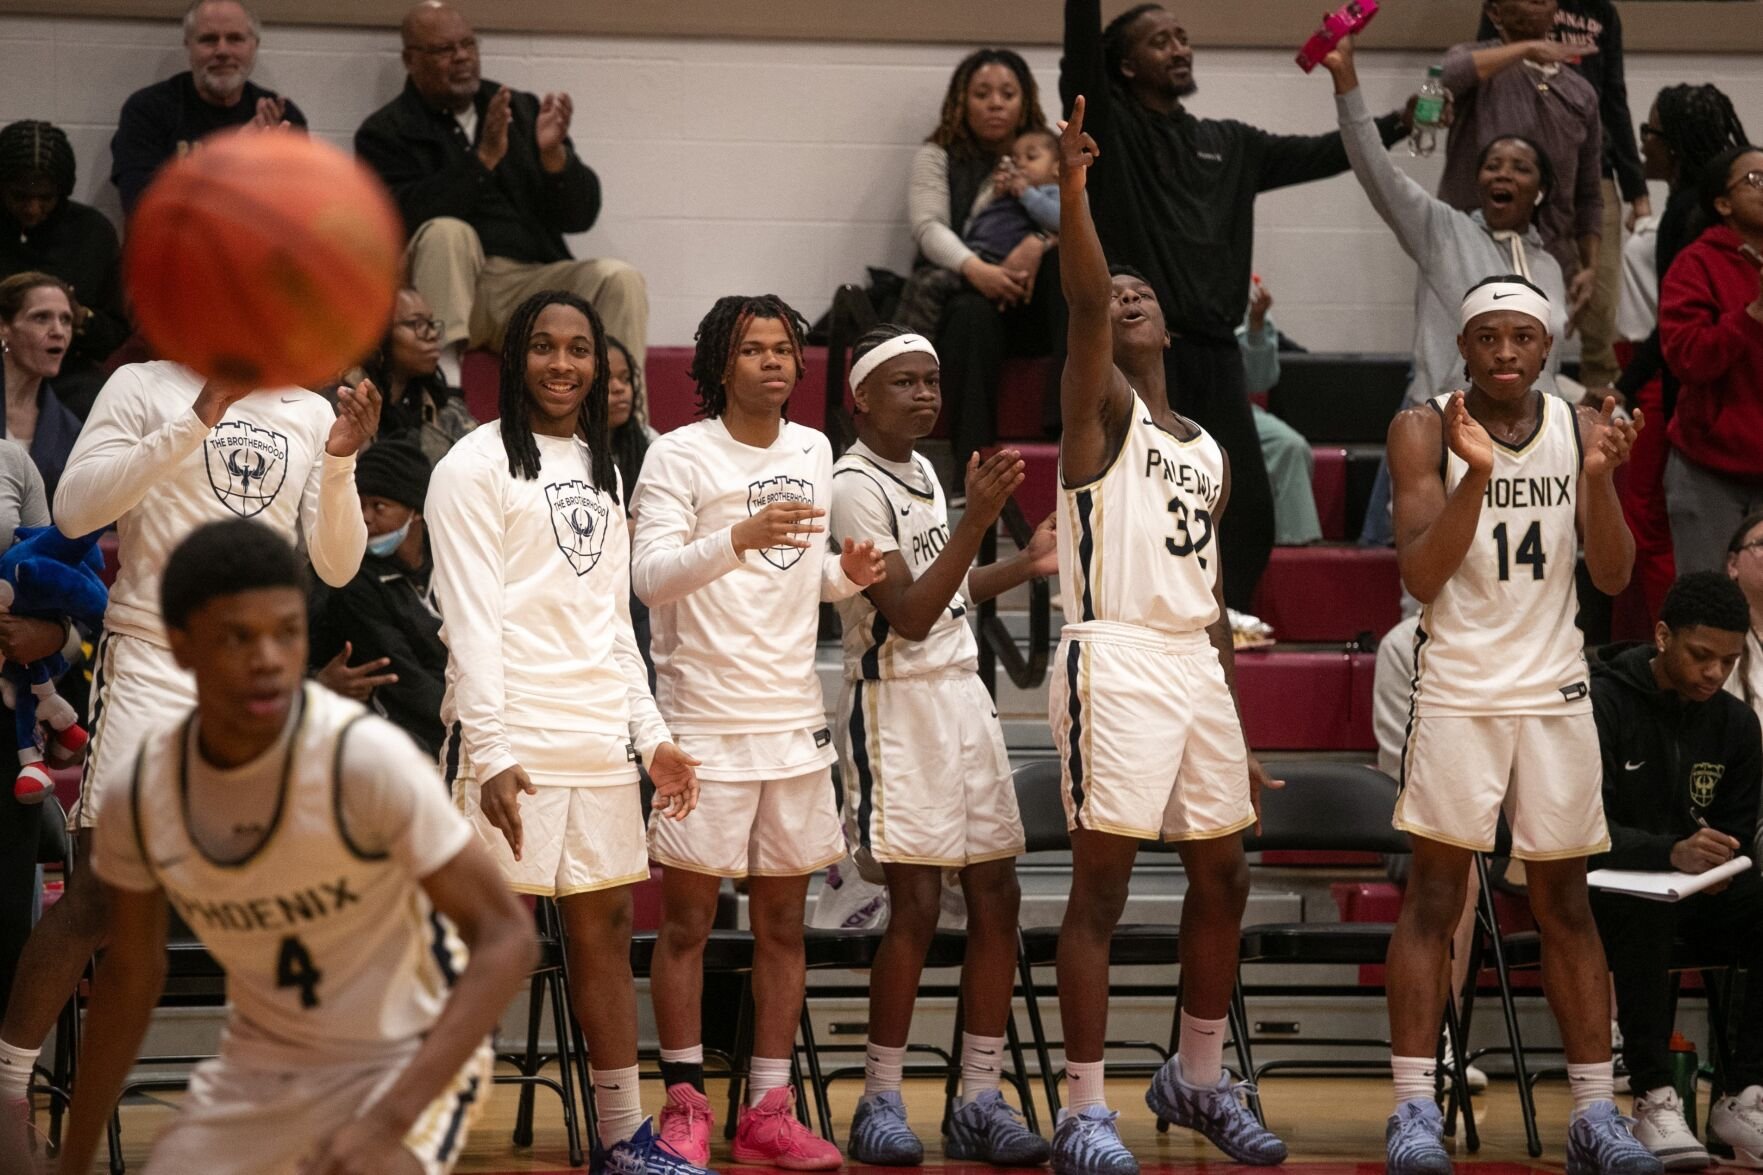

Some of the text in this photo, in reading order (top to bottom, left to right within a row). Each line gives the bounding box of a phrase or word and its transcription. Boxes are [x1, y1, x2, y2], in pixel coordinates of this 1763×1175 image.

[209, 436, 285, 461] THE BROTHERHOOD
[554, 499, 566, 511] THE
[752, 496, 766, 508] THE
[1484, 474, 1571, 508] HOENIX
[1165, 496, 1212, 570] 32
[1492, 520, 1546, 581] 14
[176, 877, 358, 931] PHOENIX
[276, 934, 322, 1010] 4
